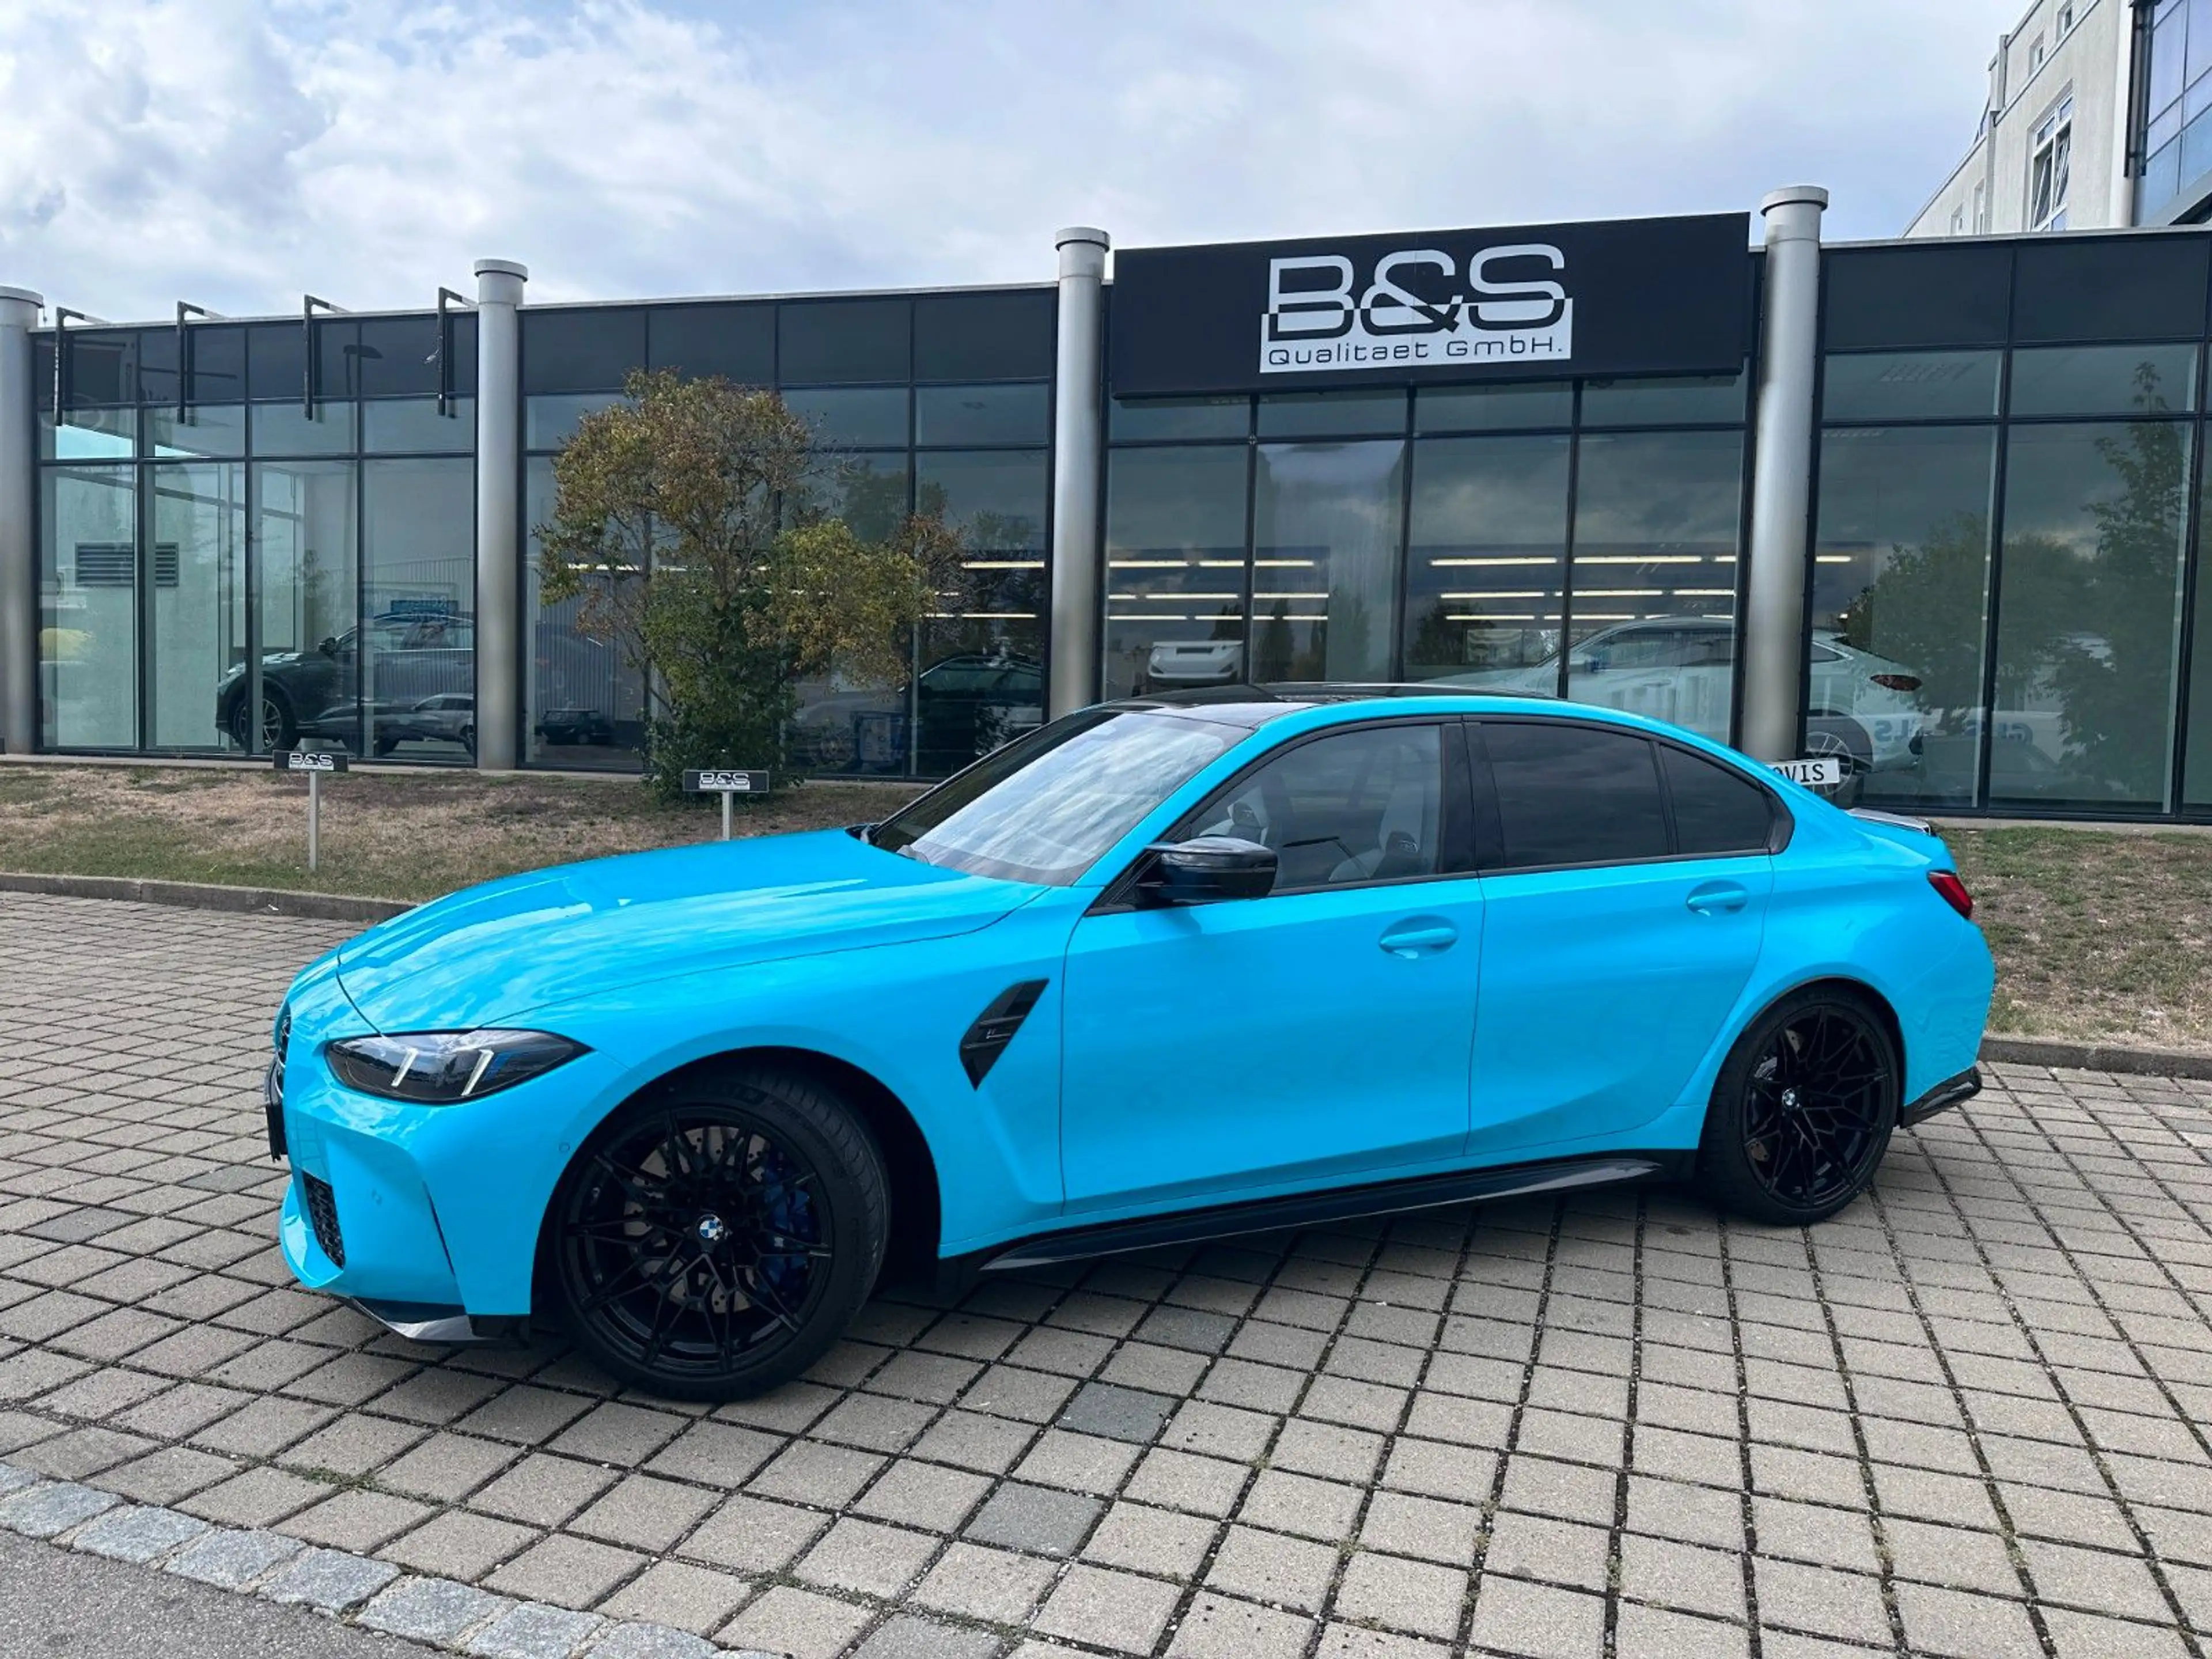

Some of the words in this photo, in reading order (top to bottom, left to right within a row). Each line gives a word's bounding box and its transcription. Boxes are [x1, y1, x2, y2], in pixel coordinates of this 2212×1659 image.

[1267, 243, 1566, 342] B&S
[1268, 342, 1429, 365] Qualitaet
[1446, 336, 1563, 357] GmbH.
[289, 753, 333, 766] B&S
[700, 772, 749, 786] B&S
